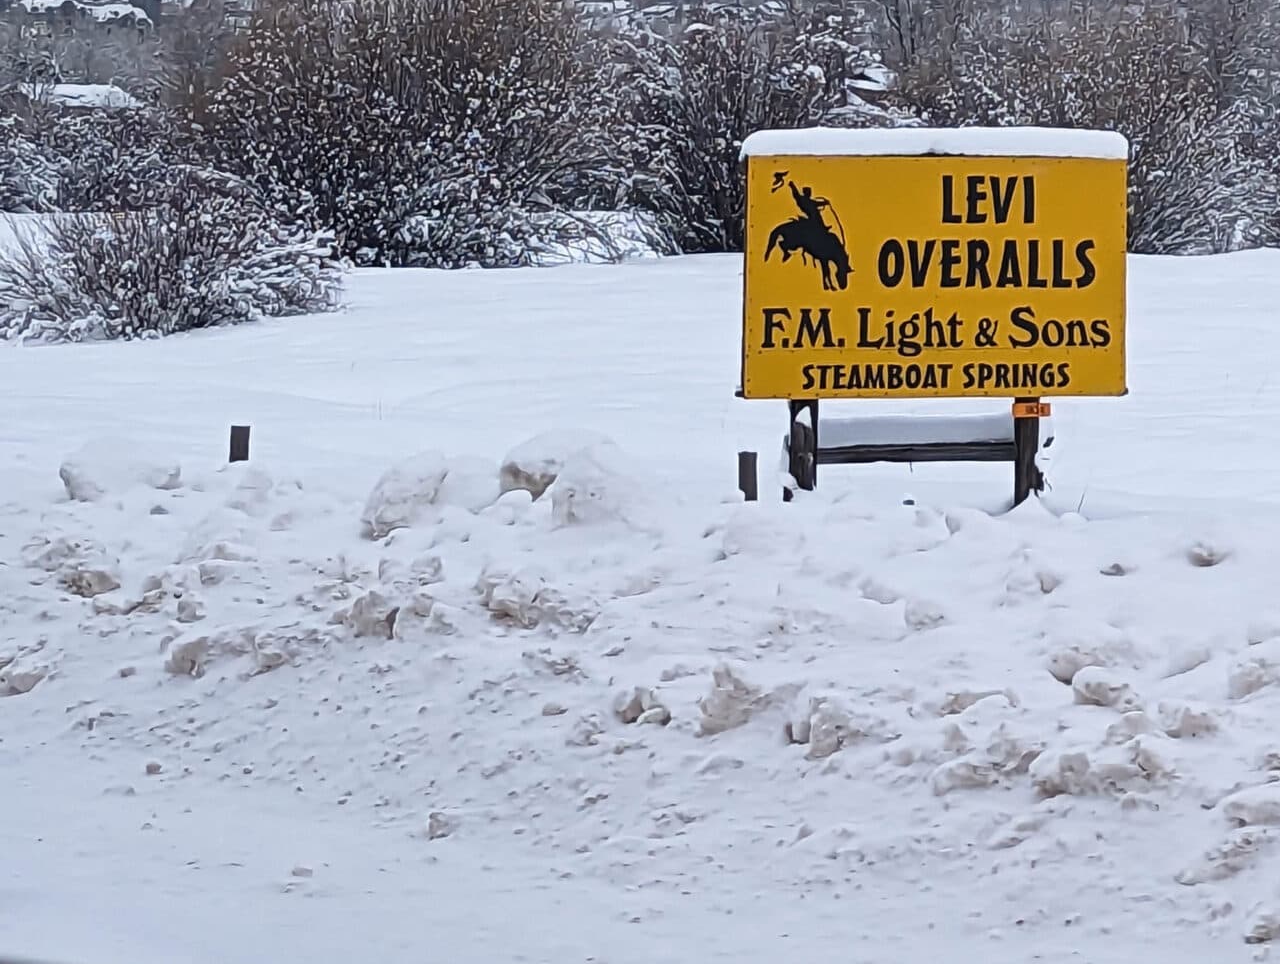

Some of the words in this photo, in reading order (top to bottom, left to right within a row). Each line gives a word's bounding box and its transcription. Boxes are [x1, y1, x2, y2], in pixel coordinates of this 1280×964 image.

[942, 176, 1034, 223] LEVI
[878, 239, 1095, 288] OVERALLS
[761, 308, 845, 348] F.M.
[857, 308, 963, 356] Light
[975, 318, 998, 347] &
[1009, 307, 1110, 348] Sons
[803, 364, 952, 389] STEAMBOAT
[963, 363, 1069, 388] SPRINGS
